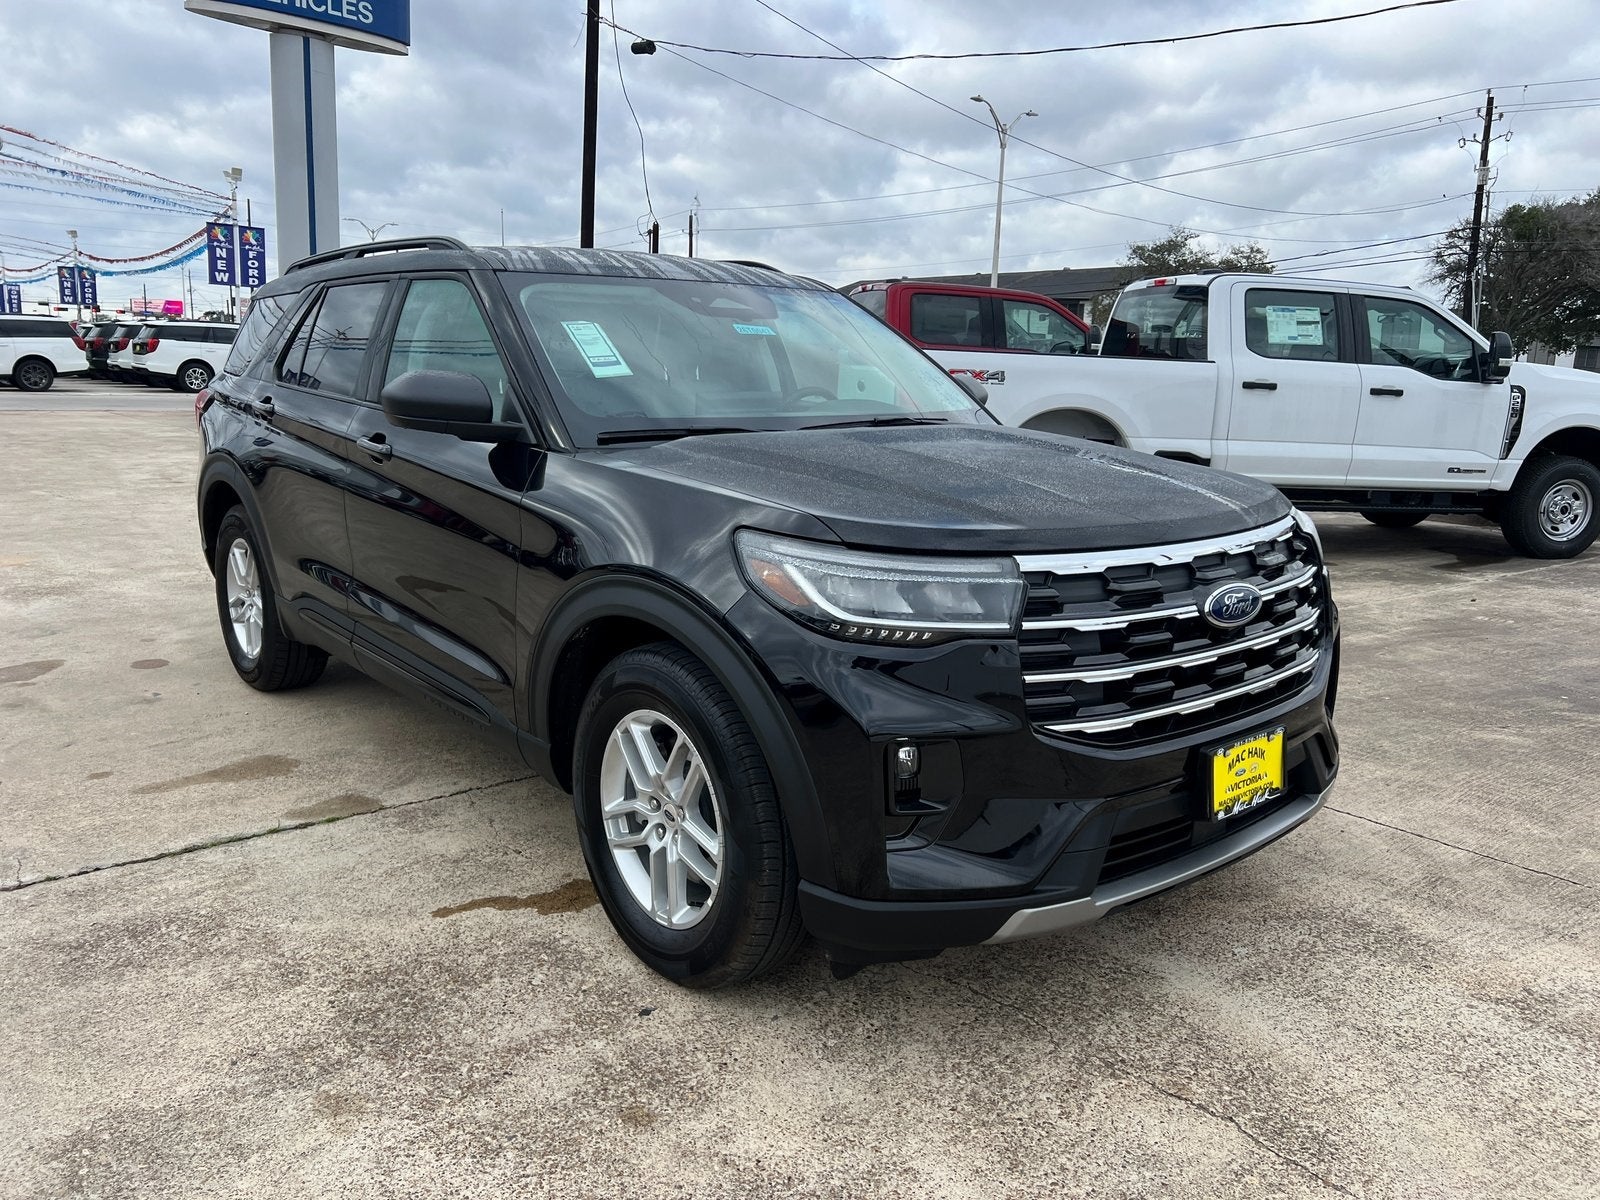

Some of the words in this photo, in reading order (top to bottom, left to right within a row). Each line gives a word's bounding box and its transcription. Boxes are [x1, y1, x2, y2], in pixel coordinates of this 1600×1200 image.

[267, 0, 374, 24] CLES
[215, 247, 229, 283] NEW
[247, 250, 259, 286] FORD
[63, 281, 73, 303] NEW
[84, 282, 93, 304] FORD
[1222, 592, 1254, 618] Ford
[1227, 749, 1246, 774] MAC
[1247, 747, 1266, 761] HAIK
[1229, 773, 1264, 792] VICTORIA
[1232, 799, 1251, 815] Mac
